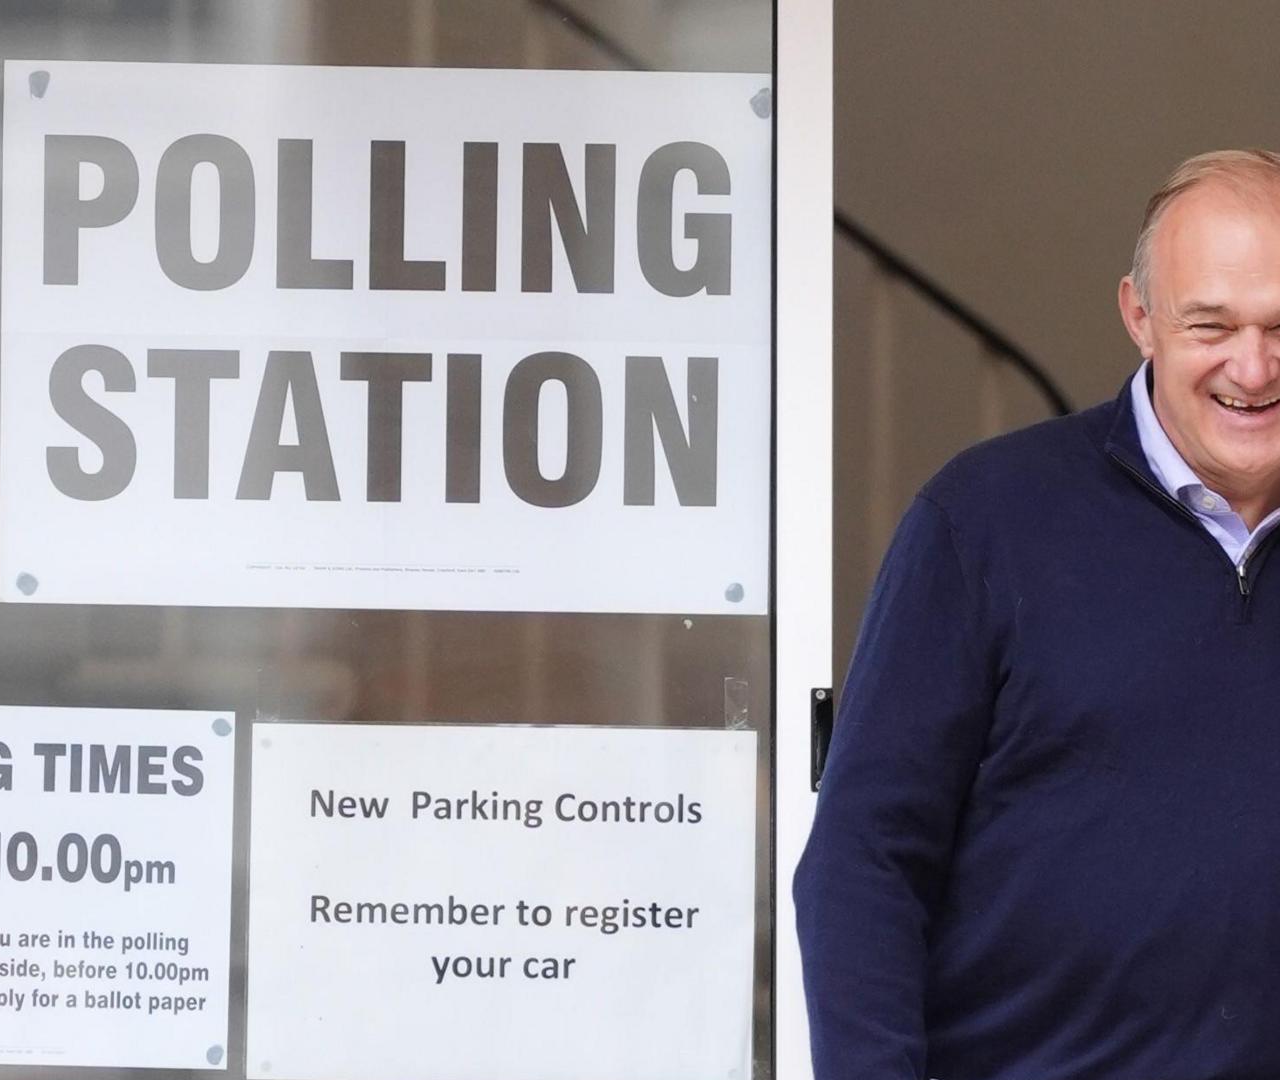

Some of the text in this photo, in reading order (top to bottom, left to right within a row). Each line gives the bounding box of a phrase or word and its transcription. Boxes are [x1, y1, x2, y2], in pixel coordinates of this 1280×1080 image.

[43, 133, 732, 298] POLLING
[46, 344, 719, 509] STATION
[33, 742, 204, 797] TIMES
[310, 789, 702, 828] New Parking Controls
[310, 894, 699, 935] Remember to register
[18, 933, 51, 948] are
[58, 929, 75, 948] in
[82, 930, 114, 950] the
[121, 931, 189, 956] polling
[53, 959, 117, 979] before
[125, 961, 209, 986] 10.00pm
[431, 956, 576, 985] your car
[31, 988, 59, 1008] for
[65, 993, 77, 1008] a
[84, 990, 141, 1010] ballot
[148, 995, 206, 1015] paper
